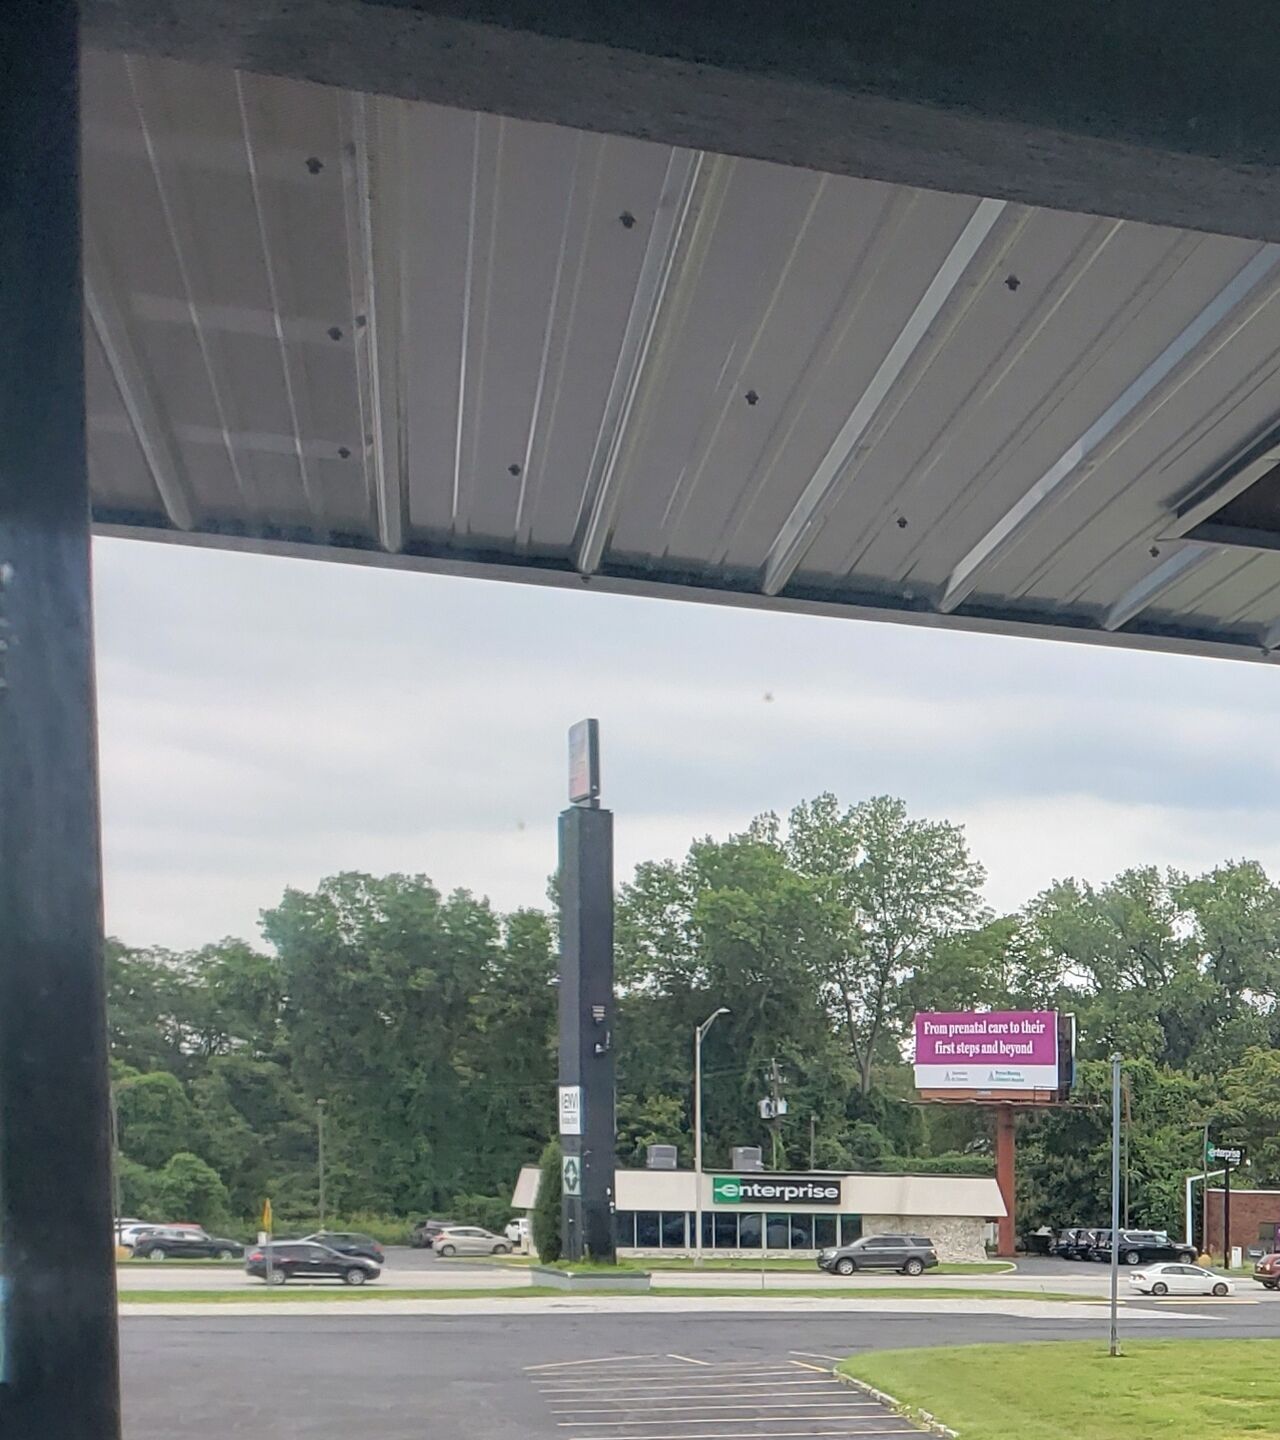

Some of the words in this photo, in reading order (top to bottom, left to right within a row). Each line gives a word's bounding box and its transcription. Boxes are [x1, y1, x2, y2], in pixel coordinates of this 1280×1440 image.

[924, 1021, 948, 1035] From
[949, 1020, 987, 1038] prenatal
[988, 1023, 1009, 1034] care
[1010, 1021, 1020, 1034] to
[1021, 1020, 1046, 1034] their
[935, 1040, 955, 1054] first
[956, 1042, 980, 1057] steps
[981, 1040, 998, 1054] and
[1000, 1040, 1033, 1057] beyond
[714, 1183, 839, 1201] enterprise
